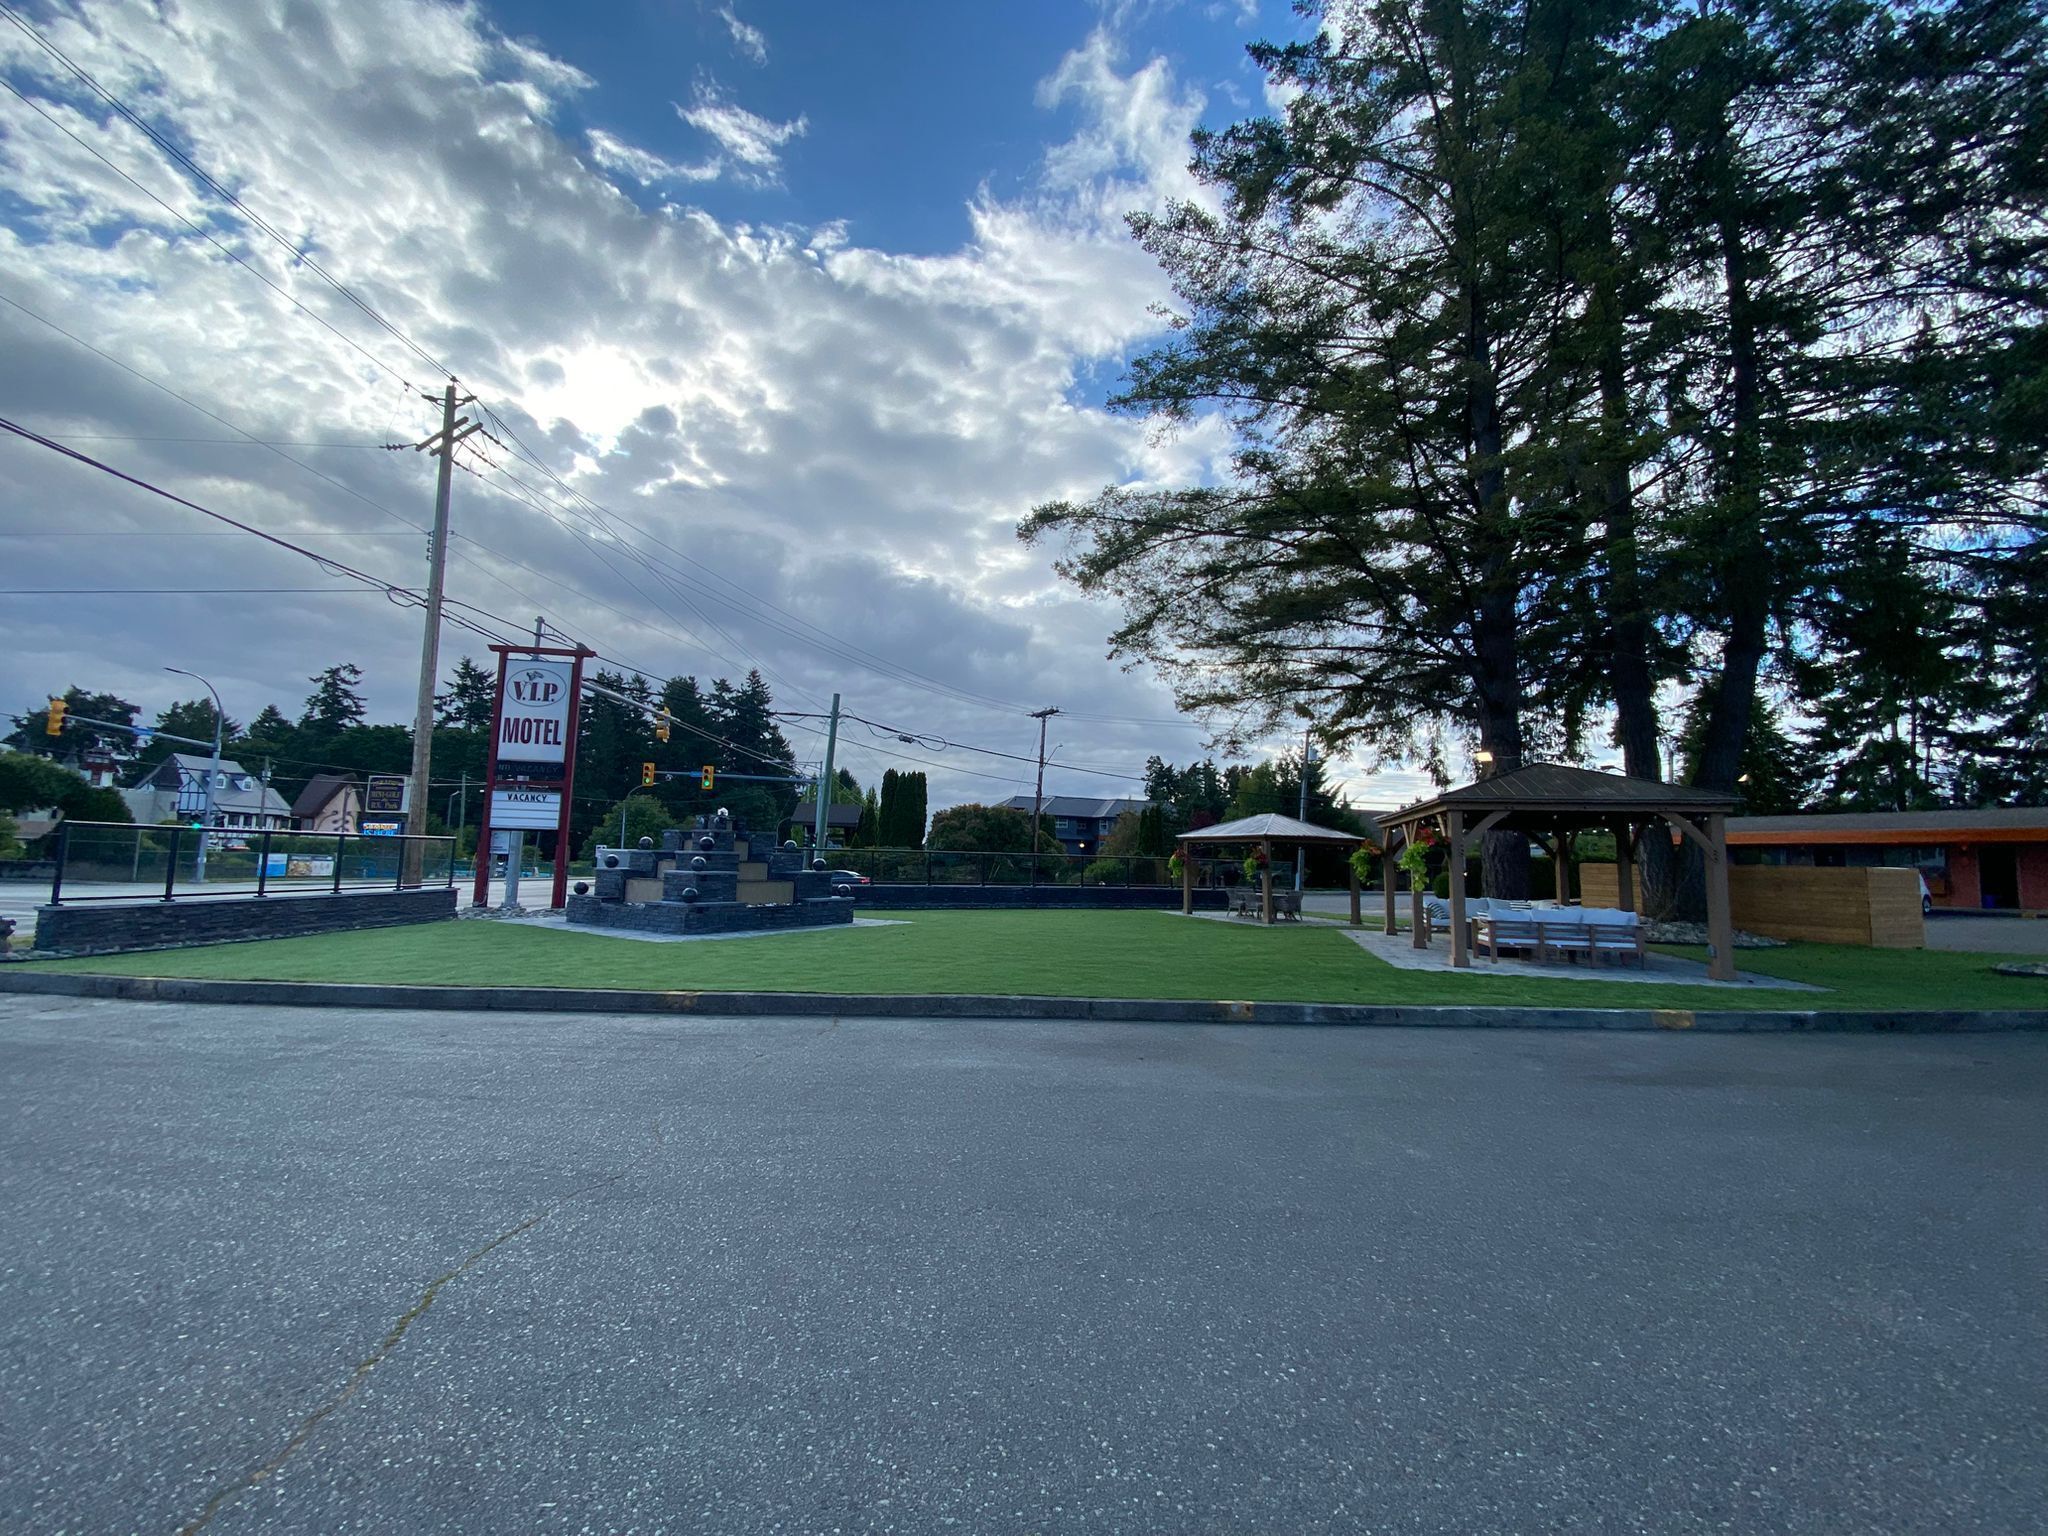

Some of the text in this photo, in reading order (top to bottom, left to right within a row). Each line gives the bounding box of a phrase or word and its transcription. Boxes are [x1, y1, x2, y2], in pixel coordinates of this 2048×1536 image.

[513, 680, 559, 702] V.I.P.
[502, 717, 562, 746] MOTEL
[507, 793, 548, 803] VACANCY
